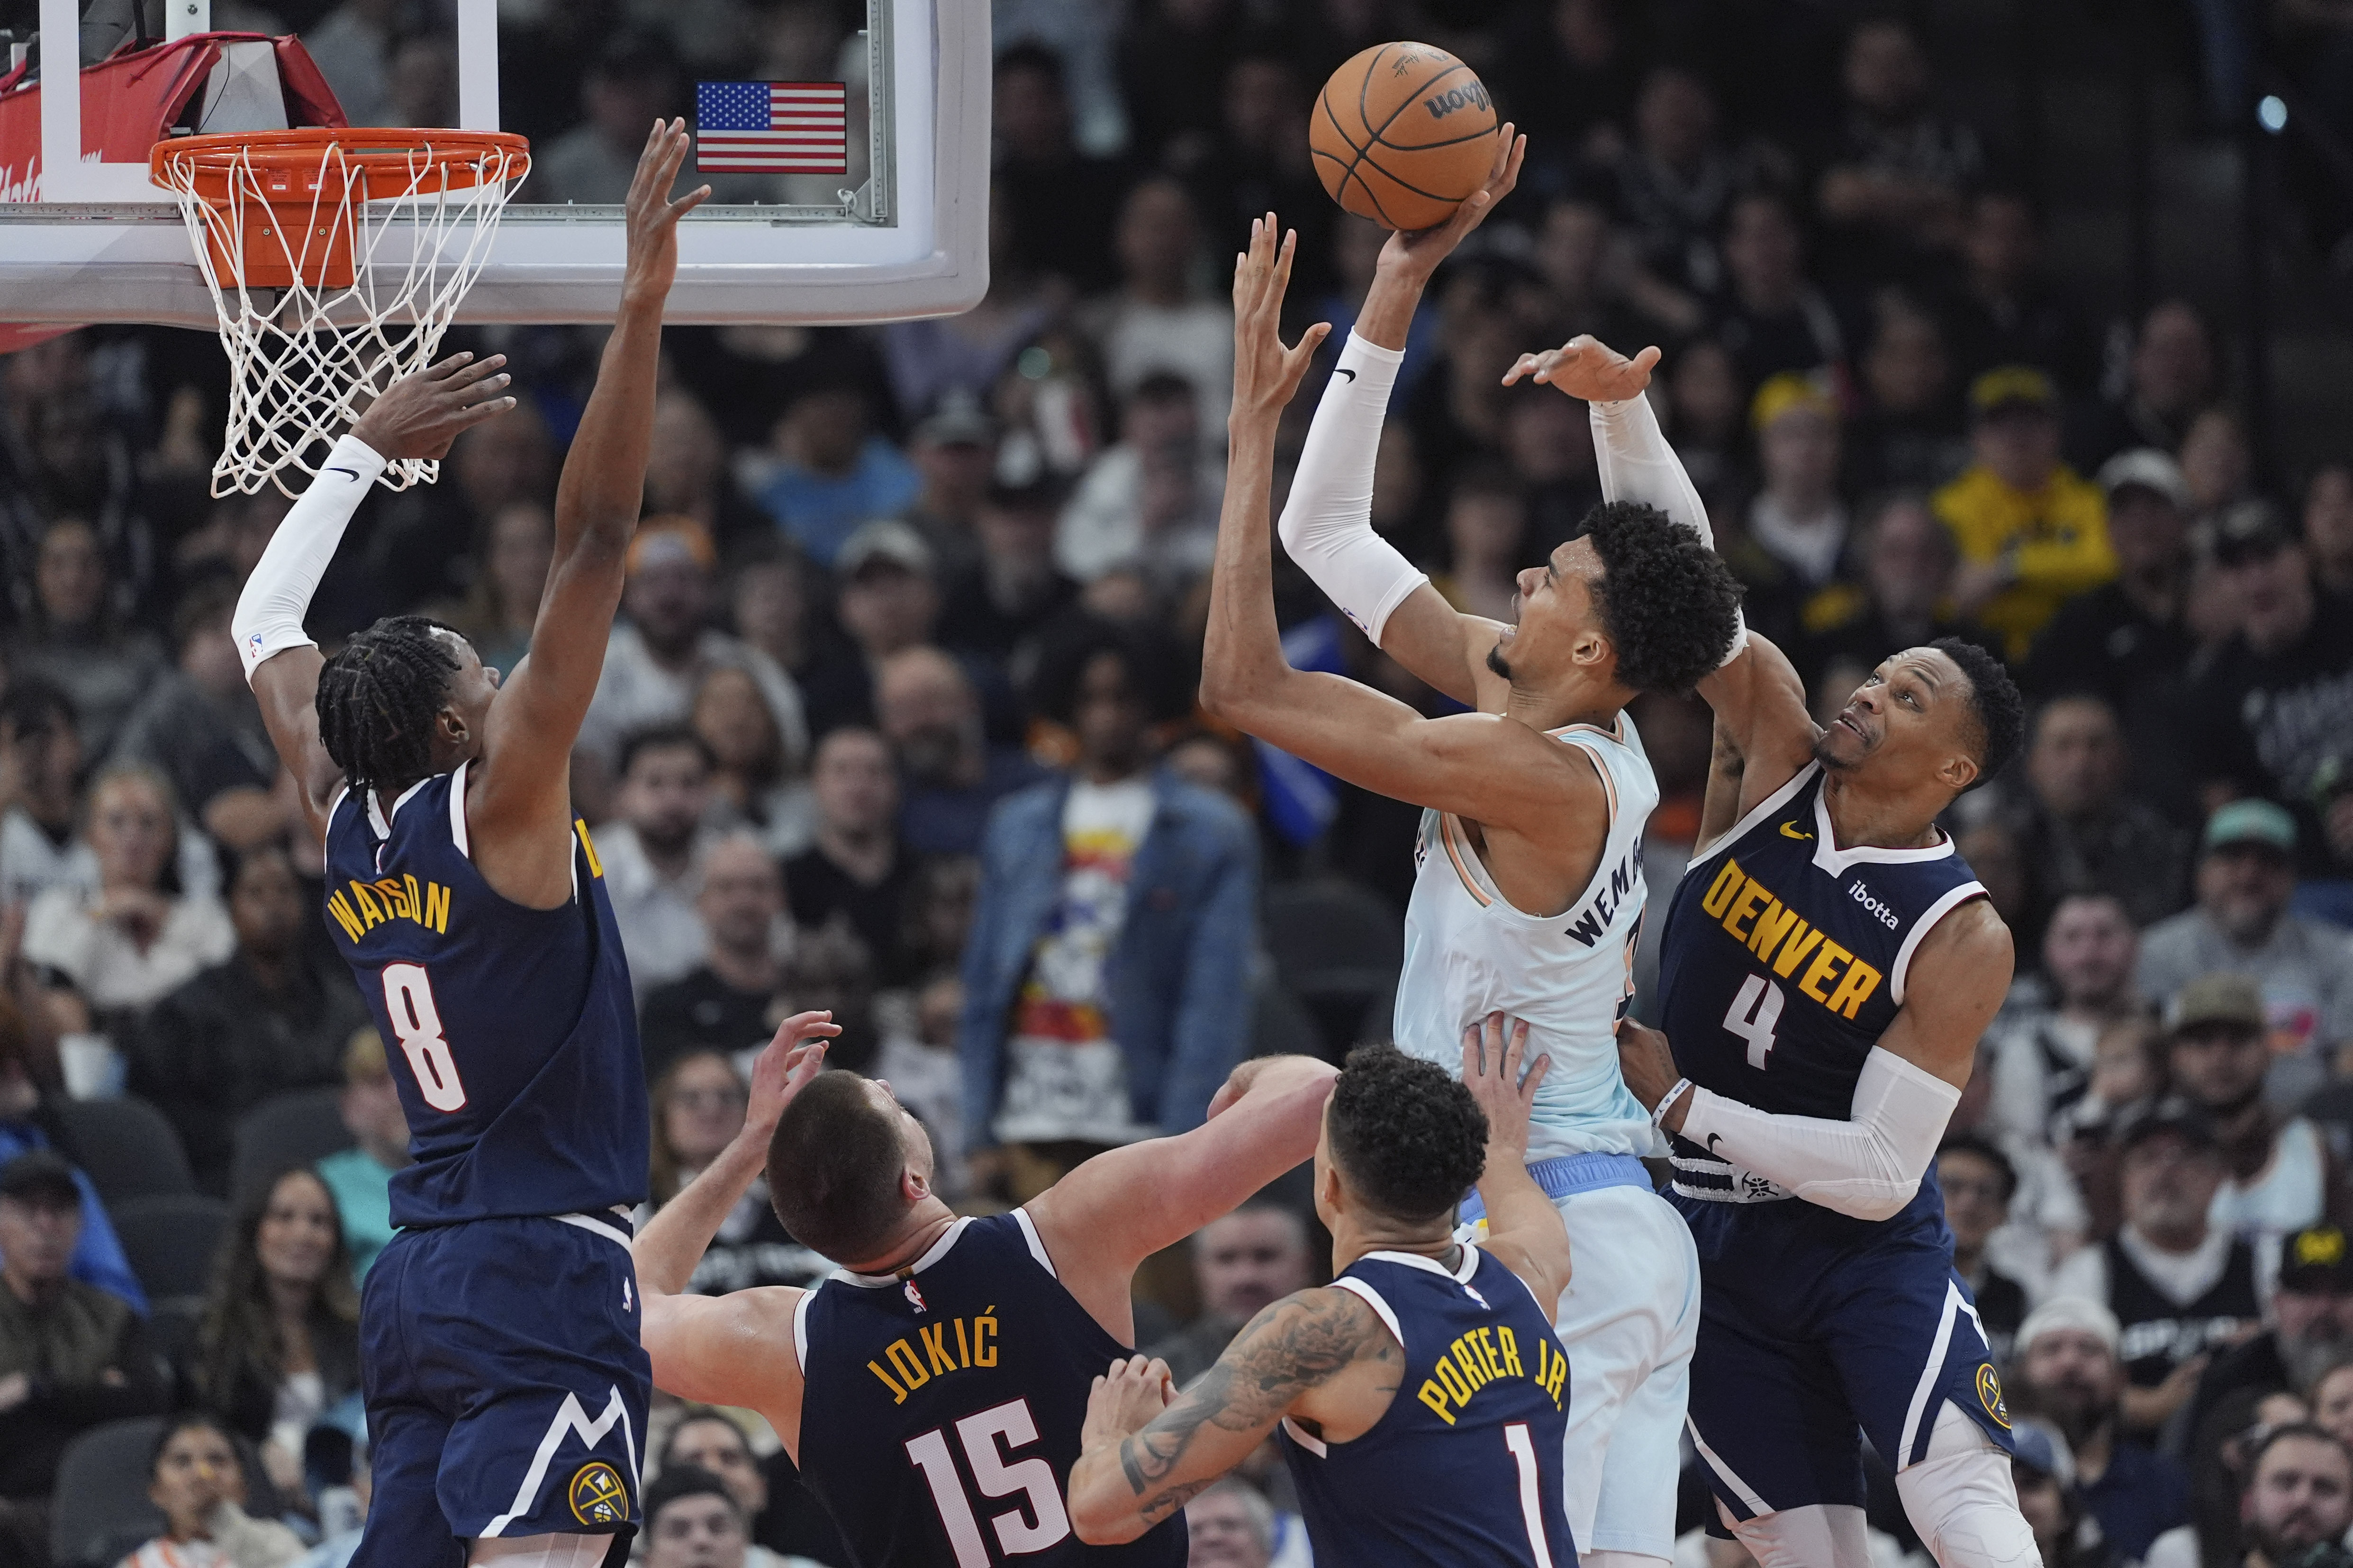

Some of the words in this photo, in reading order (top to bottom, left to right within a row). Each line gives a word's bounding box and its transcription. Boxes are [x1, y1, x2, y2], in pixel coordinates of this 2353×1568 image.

[327, 873, 451, 945] WATSON
[1701, 857, 1884, 1020] DENVER
[1848, 879, 1899, 930] ibotta
[381, 960, 469, 1114] 8
[1721, 971, 1785, 1071] 4
[867, 1305, 997, 1405] JOKIĆ
[1418, 1326, 1524, 1425] PORTER
[1535, 1338, 1567, 1413] JR.
[901, 1394, 1073, 1568] 15
[1503, 1421, 1554, 1568] 1
